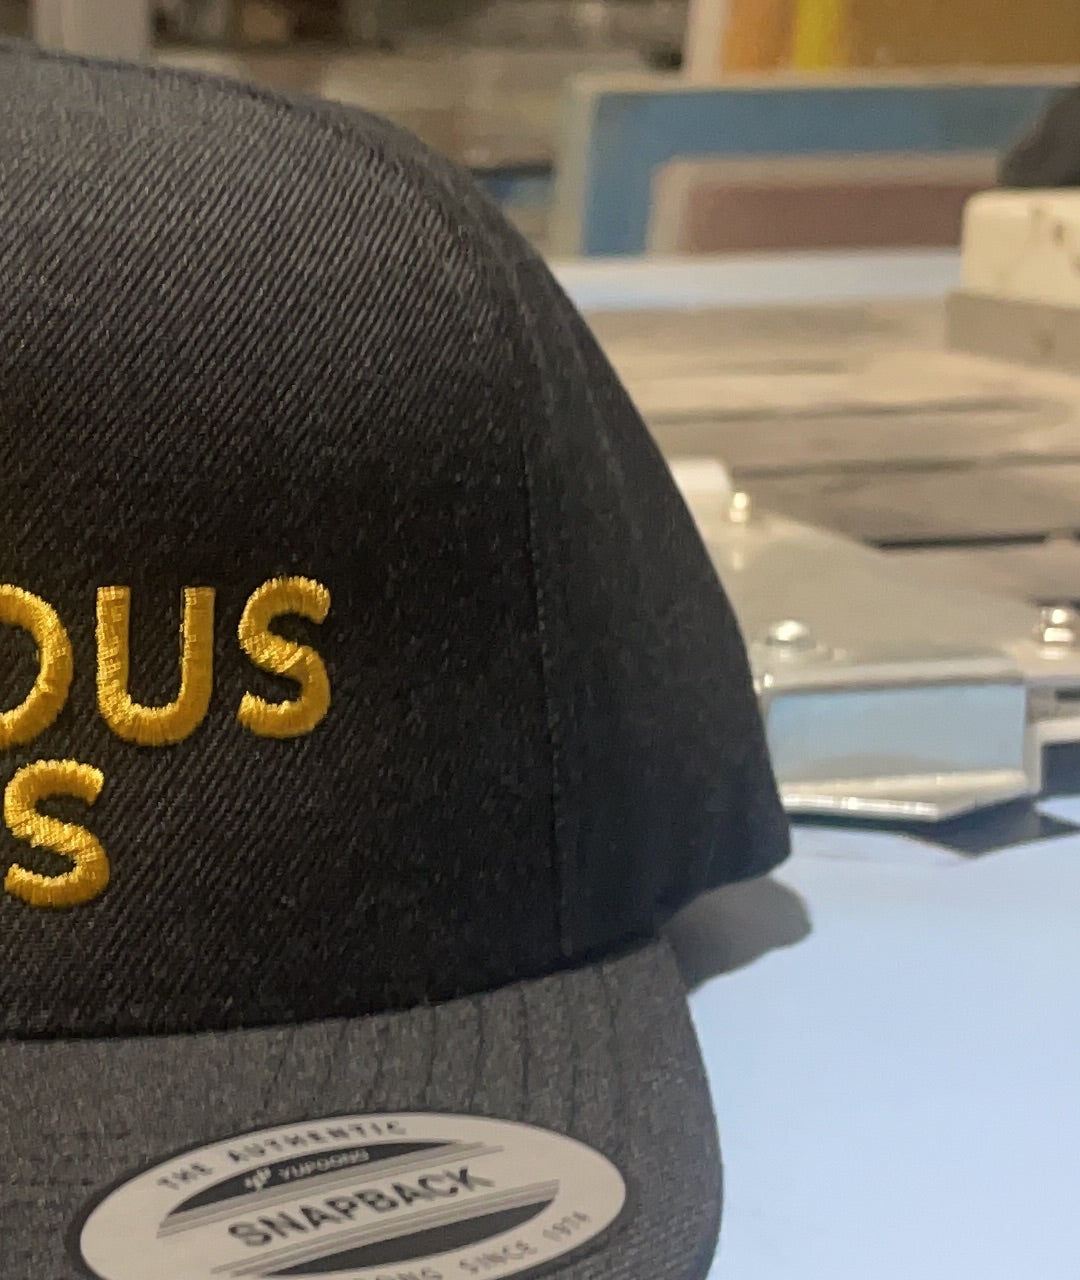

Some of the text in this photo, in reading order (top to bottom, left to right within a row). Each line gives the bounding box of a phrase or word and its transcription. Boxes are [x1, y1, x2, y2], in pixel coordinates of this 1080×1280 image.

[157, 1121, 408, 1192] THE AUTHENTIC
[228, 1166, 494, 1247] SNAPBACK
[459, 1239, 539, 1274] SINCE
